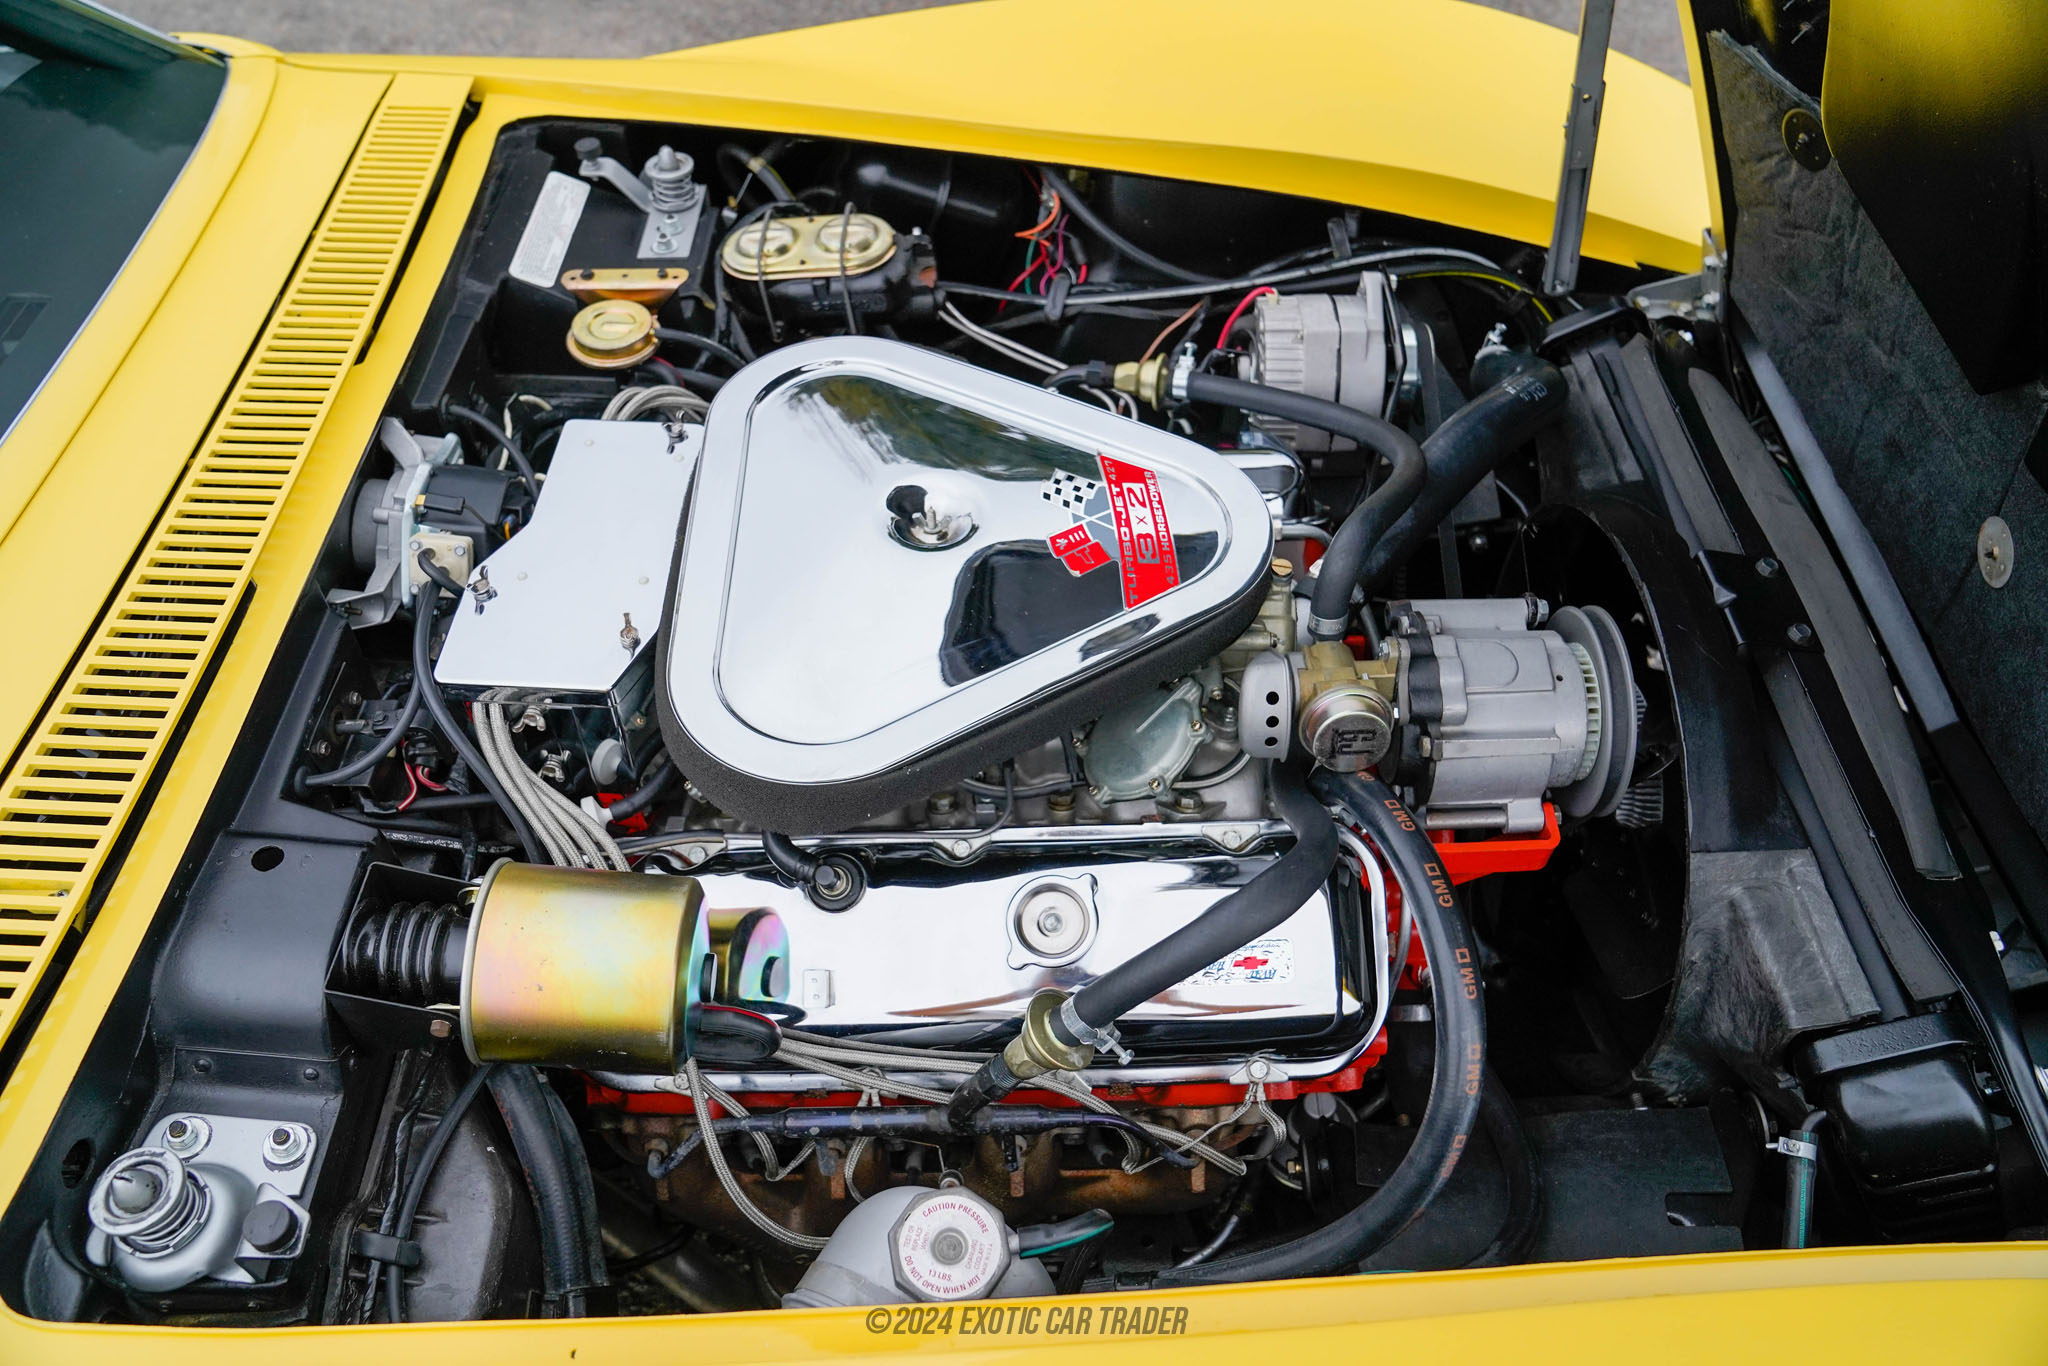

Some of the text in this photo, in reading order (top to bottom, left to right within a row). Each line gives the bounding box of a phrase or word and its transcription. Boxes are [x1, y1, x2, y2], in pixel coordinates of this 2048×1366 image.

[1144, 470, 1170, 551] HORSEPOWER
[1104, 460, 1138, 604] TURBO-JET 427
[1162, 553, 1175, 585] 435
[1393, 811, 1416, 832] GM
[1432, 879, 1454, 908] GM
[1460, 967, 1477, 1000] GM
[1466, 1063, 1480, 1095] GM
[922, 1202, 989, 1234] CAUTION PRESSURE
[904, 1255, 982, 1294] DO NOT OPEN WHEN HOT
[928, 1269, 937, 1278] 13
